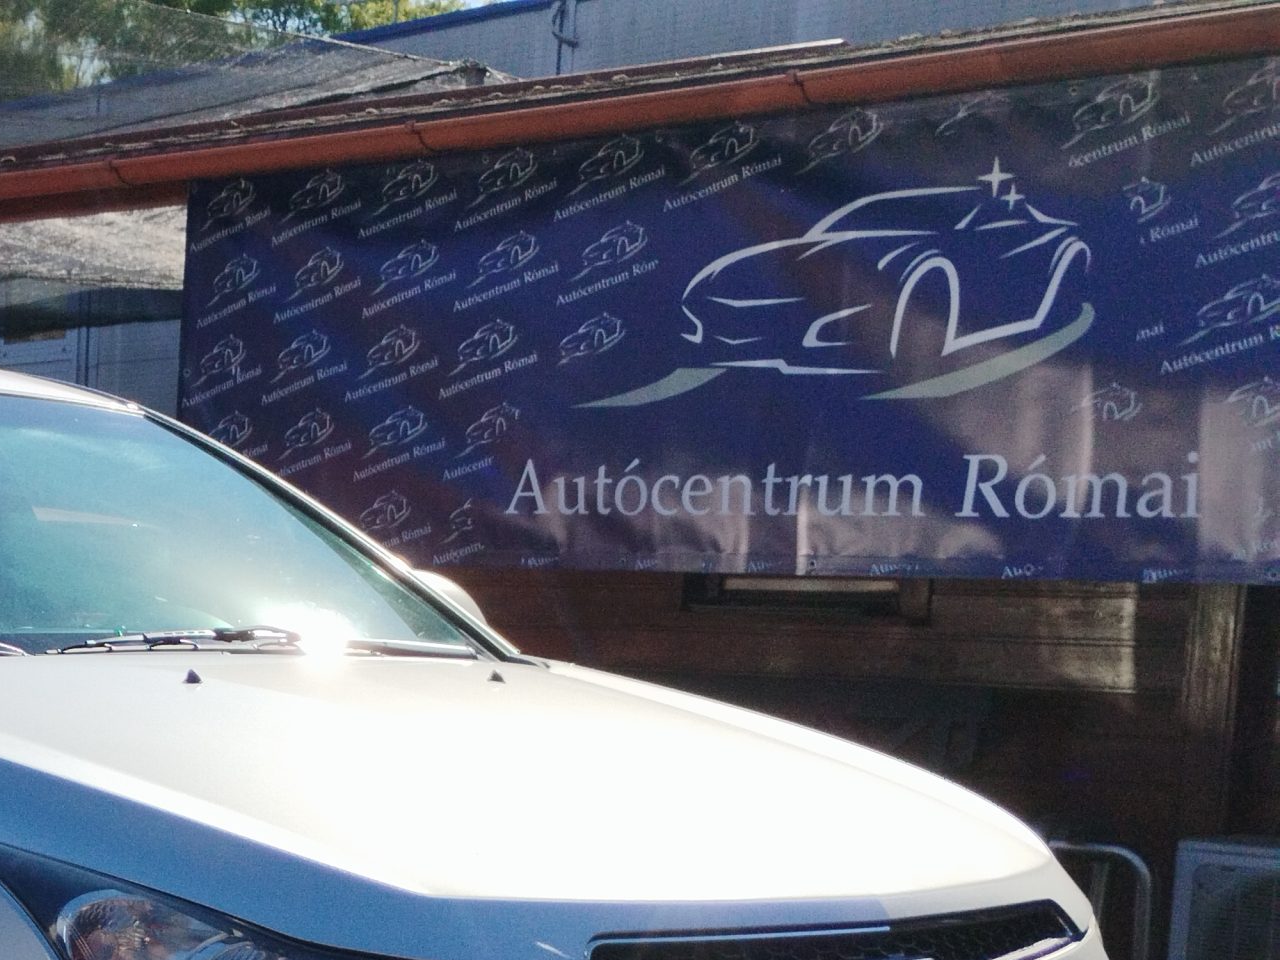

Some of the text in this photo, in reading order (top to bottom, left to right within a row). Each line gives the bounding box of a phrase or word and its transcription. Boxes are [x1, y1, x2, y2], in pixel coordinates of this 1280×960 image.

[454, 178, 558, 232] Autócentrum Római
[553, 166, 665, 222] Autócentrum Római
[663, 157, 782, 212] Autócentrum Római
[271, 200, 362, 247] Autócentrum Római
[358, 188, 458, 239] Autócentrum Római
[273, 277, 362, 324] Autócentrum Római
[361, 268, 457, 319] Autócentrum Római
[453, 262, 559, 312] Autócentrum Római
[556, 271, 629, 306] Autócentrum
[438, 353, 538, 400] Autócentrum Római
[1160, 333, 1263, 375] Autócentrum
[261, 361, 348, 406] Autócentrum Római
[344, 358, 439, 403] Autócentrum Római
[353, 438, 446, 482] Autócentrum Római
[505, 451, 1200, 518] Autócentrum Római
